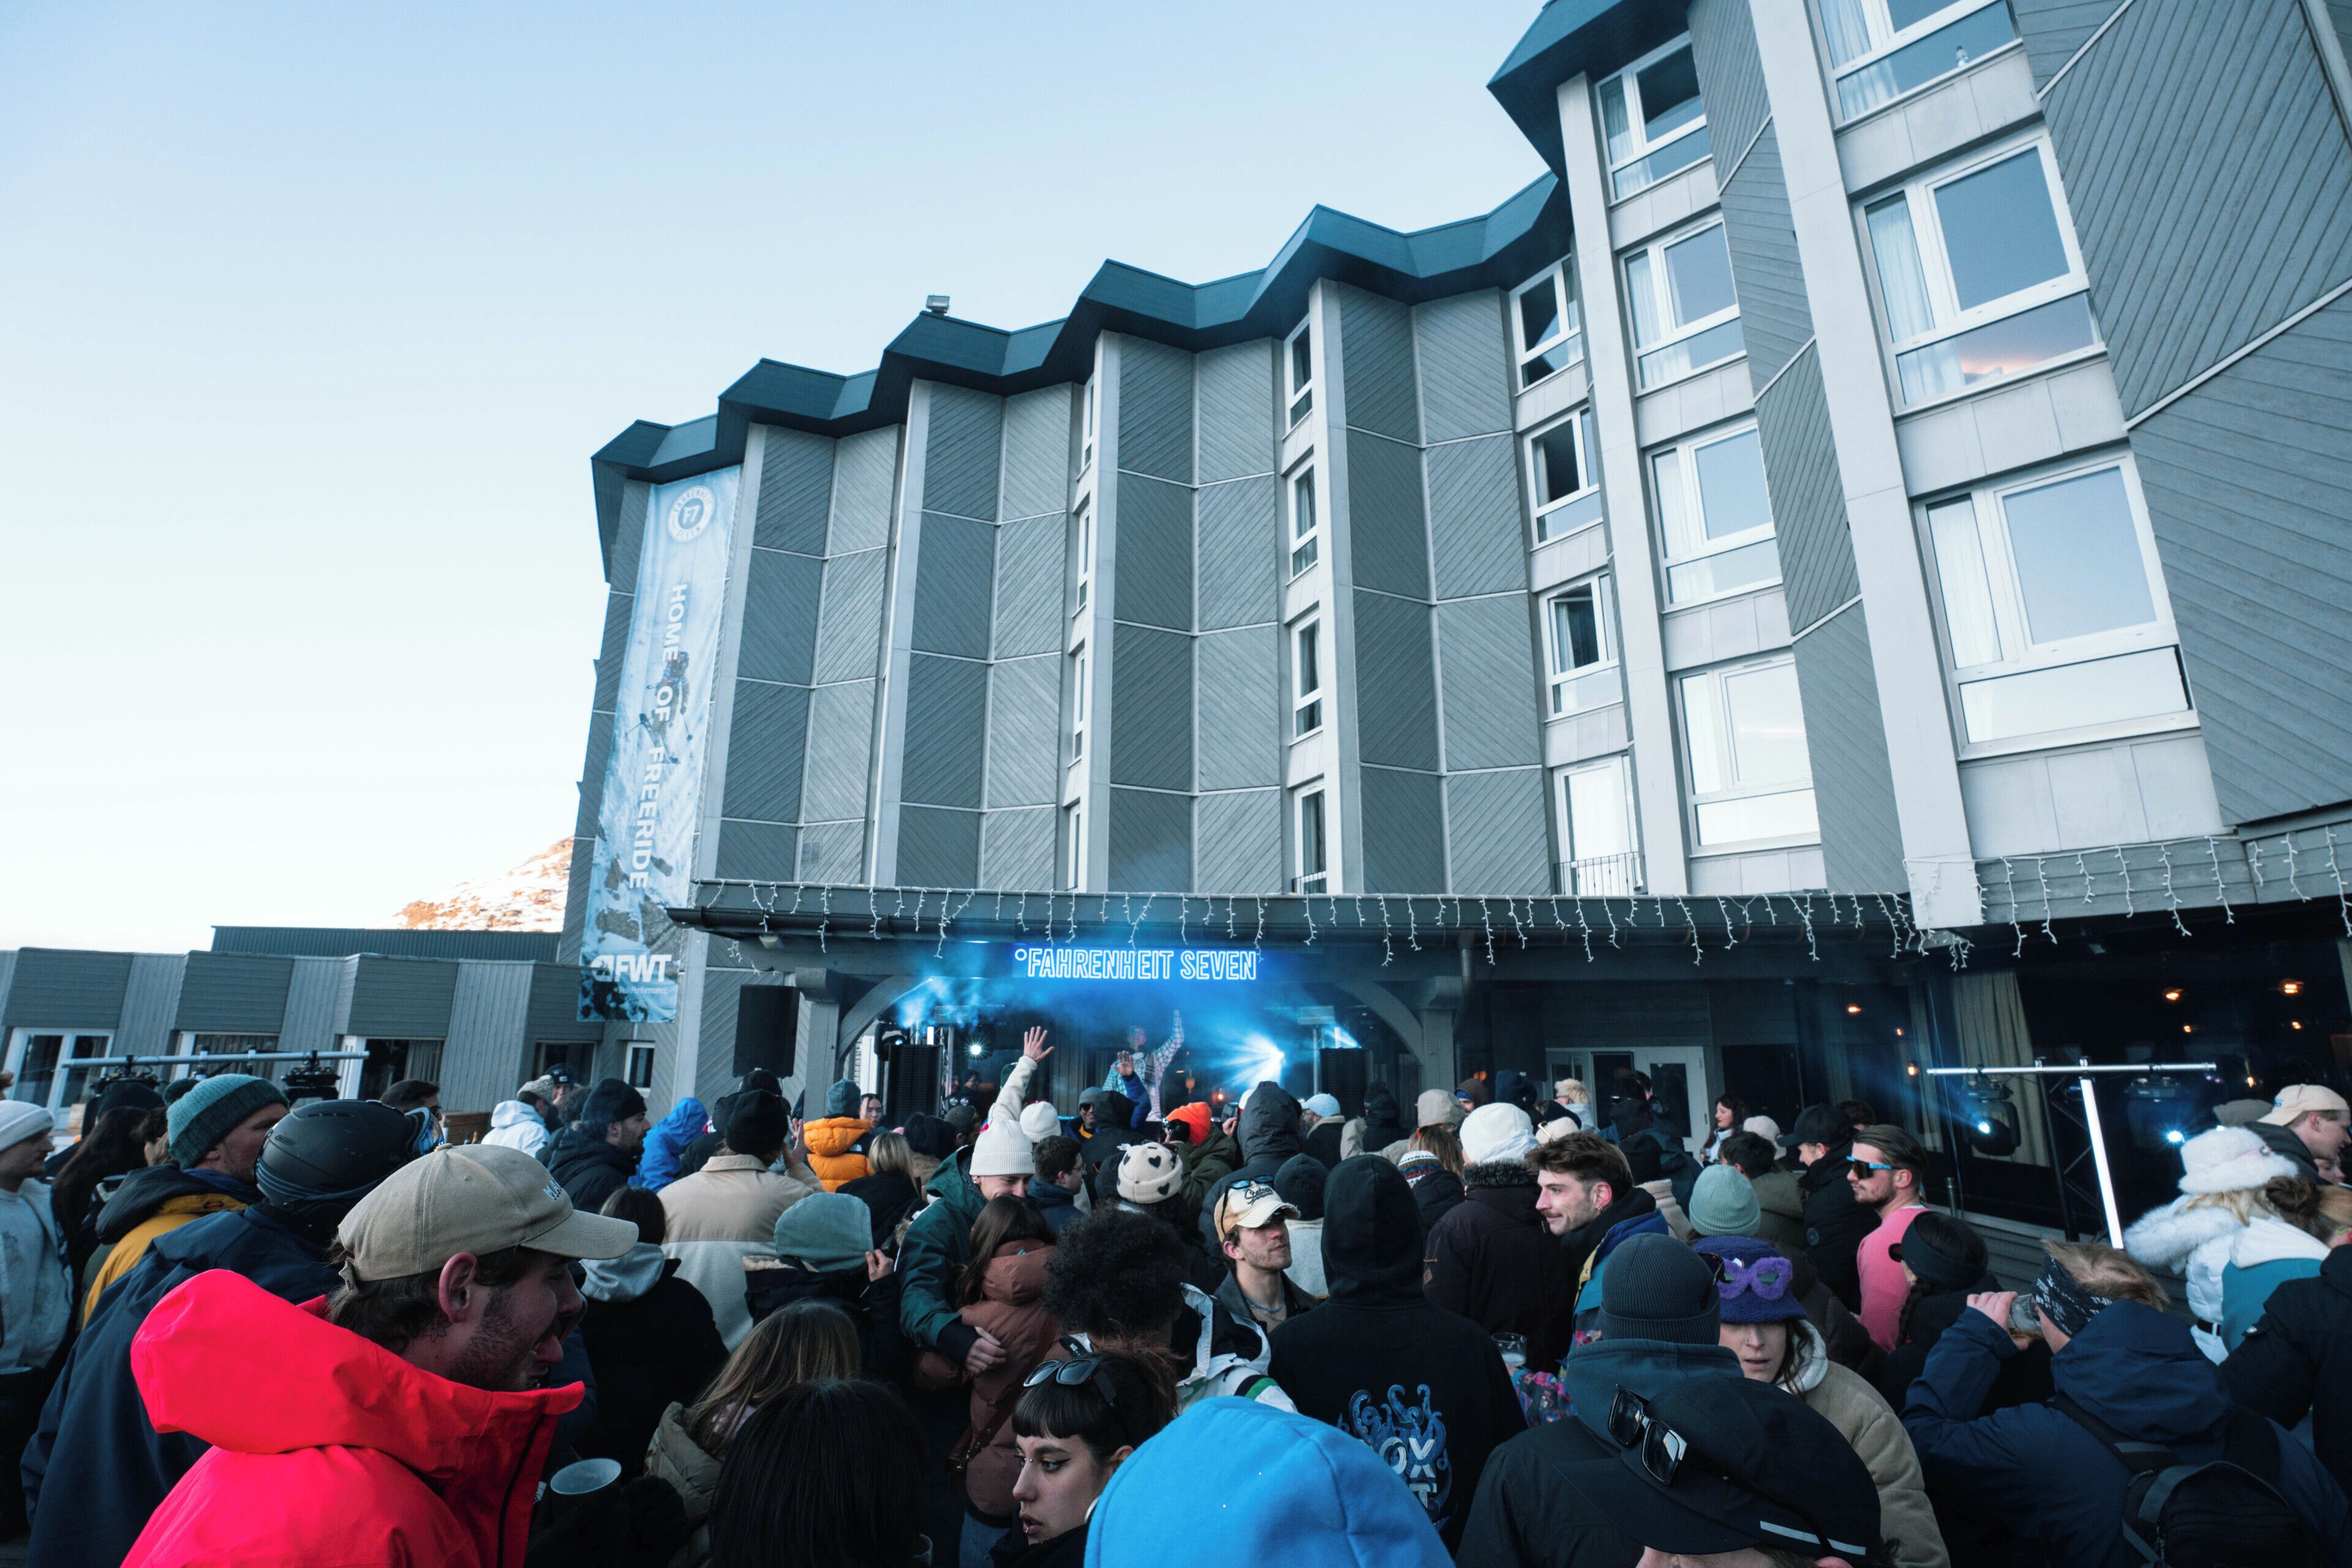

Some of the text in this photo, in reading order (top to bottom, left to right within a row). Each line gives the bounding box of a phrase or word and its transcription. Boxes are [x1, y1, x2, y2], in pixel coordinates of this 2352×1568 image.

[683, 505, 701, 524] F7
[654, 584, 687, 722] HOME OF
[629, 745, 664, 889] FREERIDE
[614, 954, 672, 982] FWT
[1180, 951, 1256, 980] SEVEN
